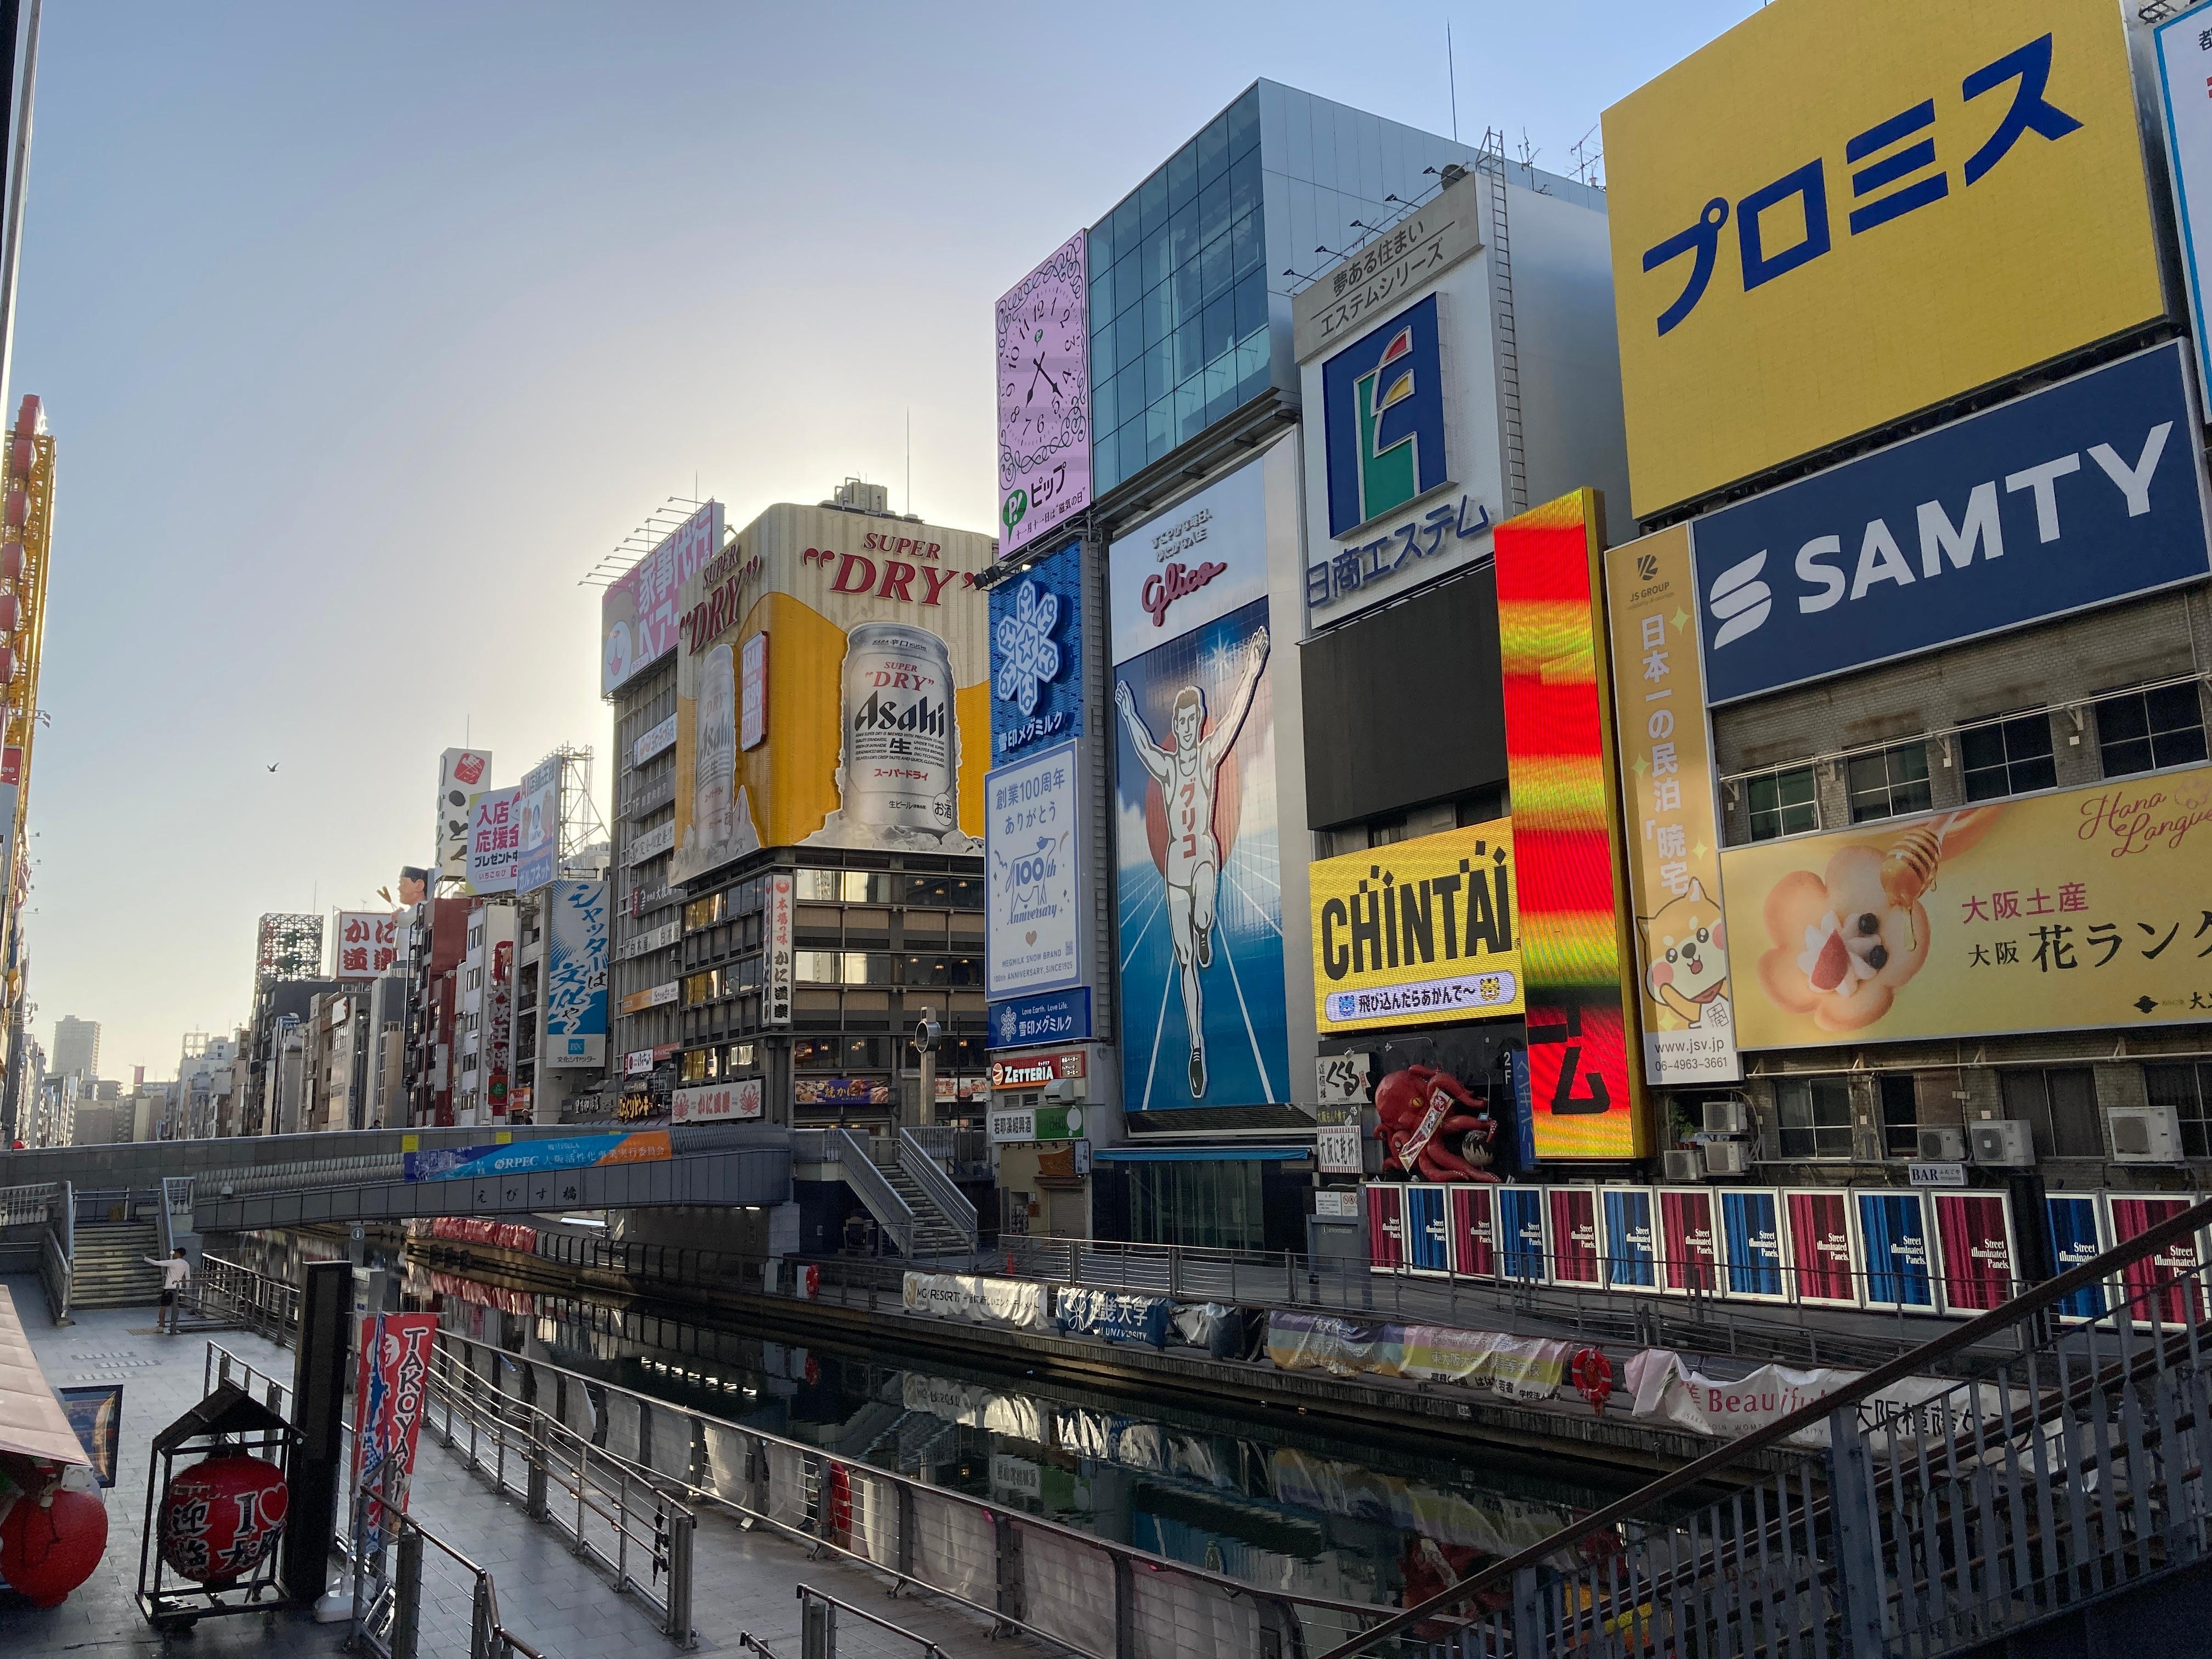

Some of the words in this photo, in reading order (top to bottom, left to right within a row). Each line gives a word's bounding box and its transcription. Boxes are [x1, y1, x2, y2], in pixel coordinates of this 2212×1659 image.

[1643, 32, 2084, 337] プロミス
[1333, 221, 1424, 297] 夢ある住まい
[1321, 236, 1444, 337] エステムシリーズ
[1032, 300, 1045, 319] 12
[1050, 296, 1057, 317] 1
[1059, 308, 1070, 329] 2
[1018, 319, 1030, 341] 11
[1064, 337, 1076, 352] 3
[1008, 346, 1020, 370] 10
[1062, 369, 1073, 385] 4
[1006, 381, 1015, 397] 9
[1010, 405, 1020, 424] 8
[1051, 400, 1060, 415] 5
[1022, 416, 1032, 436] 7
[1036, 413, 1045, 433] 6
[1031, 460, 1067, 508] ピップ
[1795, 421, 2174, 614] SAMTY
[864, 532, 941, 560] SUPER
[1306, 494, 1488, 608] 日商エステム
[639, 506, 712, 615] 家事代行
[703, 544, 740, 589] SUPER
[1142, 561, 1227, 627] Glico
[1629, 592, 1640, 602] JS
[1641, 581, 1670, 598] GROUP
[743, 642, 762, 677] ASAHI
[884, 662, 918, 673] SUPER
[743, 680, 761, 713] 1889
[854, 690, 944, 738] Asahi
[699, 710, 731, 764] Asahi
[742, 711, 761, 744] OSAKA
[889, 738, 912, 755] 生
[874, 768, 928, 781] スーパードライ
[996, 768, 1065, 810] 創業100周年
[476, 800, 509, 828] 入店
[934, 799, 952, 819] お酒
[1005, 800, 1056, 835] ありがとう
[1179, 776, 1198, 859] グリコ
[2079, 790, 2167, 840] Hana
[518, 860, 550, 891] ガルフネット
[1961, 882, 2089, 924] 大阪土産
[776, 897, 788, 945] 本場の味
[1007, 903, 1058, 926] Anniversary
[344, 918, 395, 944] かに
[630, 935, 648, 956] 白木屋
[1968, 940, 2020, 968] 大阪
[1002, 957, 1024, 967] MEGMILK
[1026, 953, 1041, 963] SNOW
[1043, 949, 1062, 960] BRAND
[774, 950, 789, 1019] かに道楽
[1019, 1015, 1072, 1036] 雪印メグミルク
[1654, 1037, 1724, 1054] www.jsv.jp
[1005, 1065, 1053, 1084] ZETTERIA
[1504, 1051, 1511, 1085] 2F
[1655, 1057, 1728, 1071] 06-4963-3661
[1325, 1060, 1360, 1097] くくる
[1912, 1169, 1938, 1181] BAR
[1579, 1224, 1593, 1232] Street
[1635, 1226, 1649, 1235] Street
[1695, 1228, 1710, 1237] Street
[1759, 1231, 1775, 1239] Street
[1828, 1233, 1845, 1242] Street
[1697, 1245, 1714, 1254] Panels.
[1903, 1235, 1921, 1245] Street
[1984, 1238, 2004, 1249] Street
[2074, 1242, 2095, 1253] Street
[2170, 1245, 2193, 1256] Street
[1761, 1248, 1779, 1257] Panels.
[1830, 1251, 1849, 1261] Panels.
[1905, 1254, 1927, 1265] Panels.
[1988, 1259, 2010, 1269] Panels.
[392, 1328, 428, 1503] TAKOYAKI
[234, 1490, 258, 1538] I
